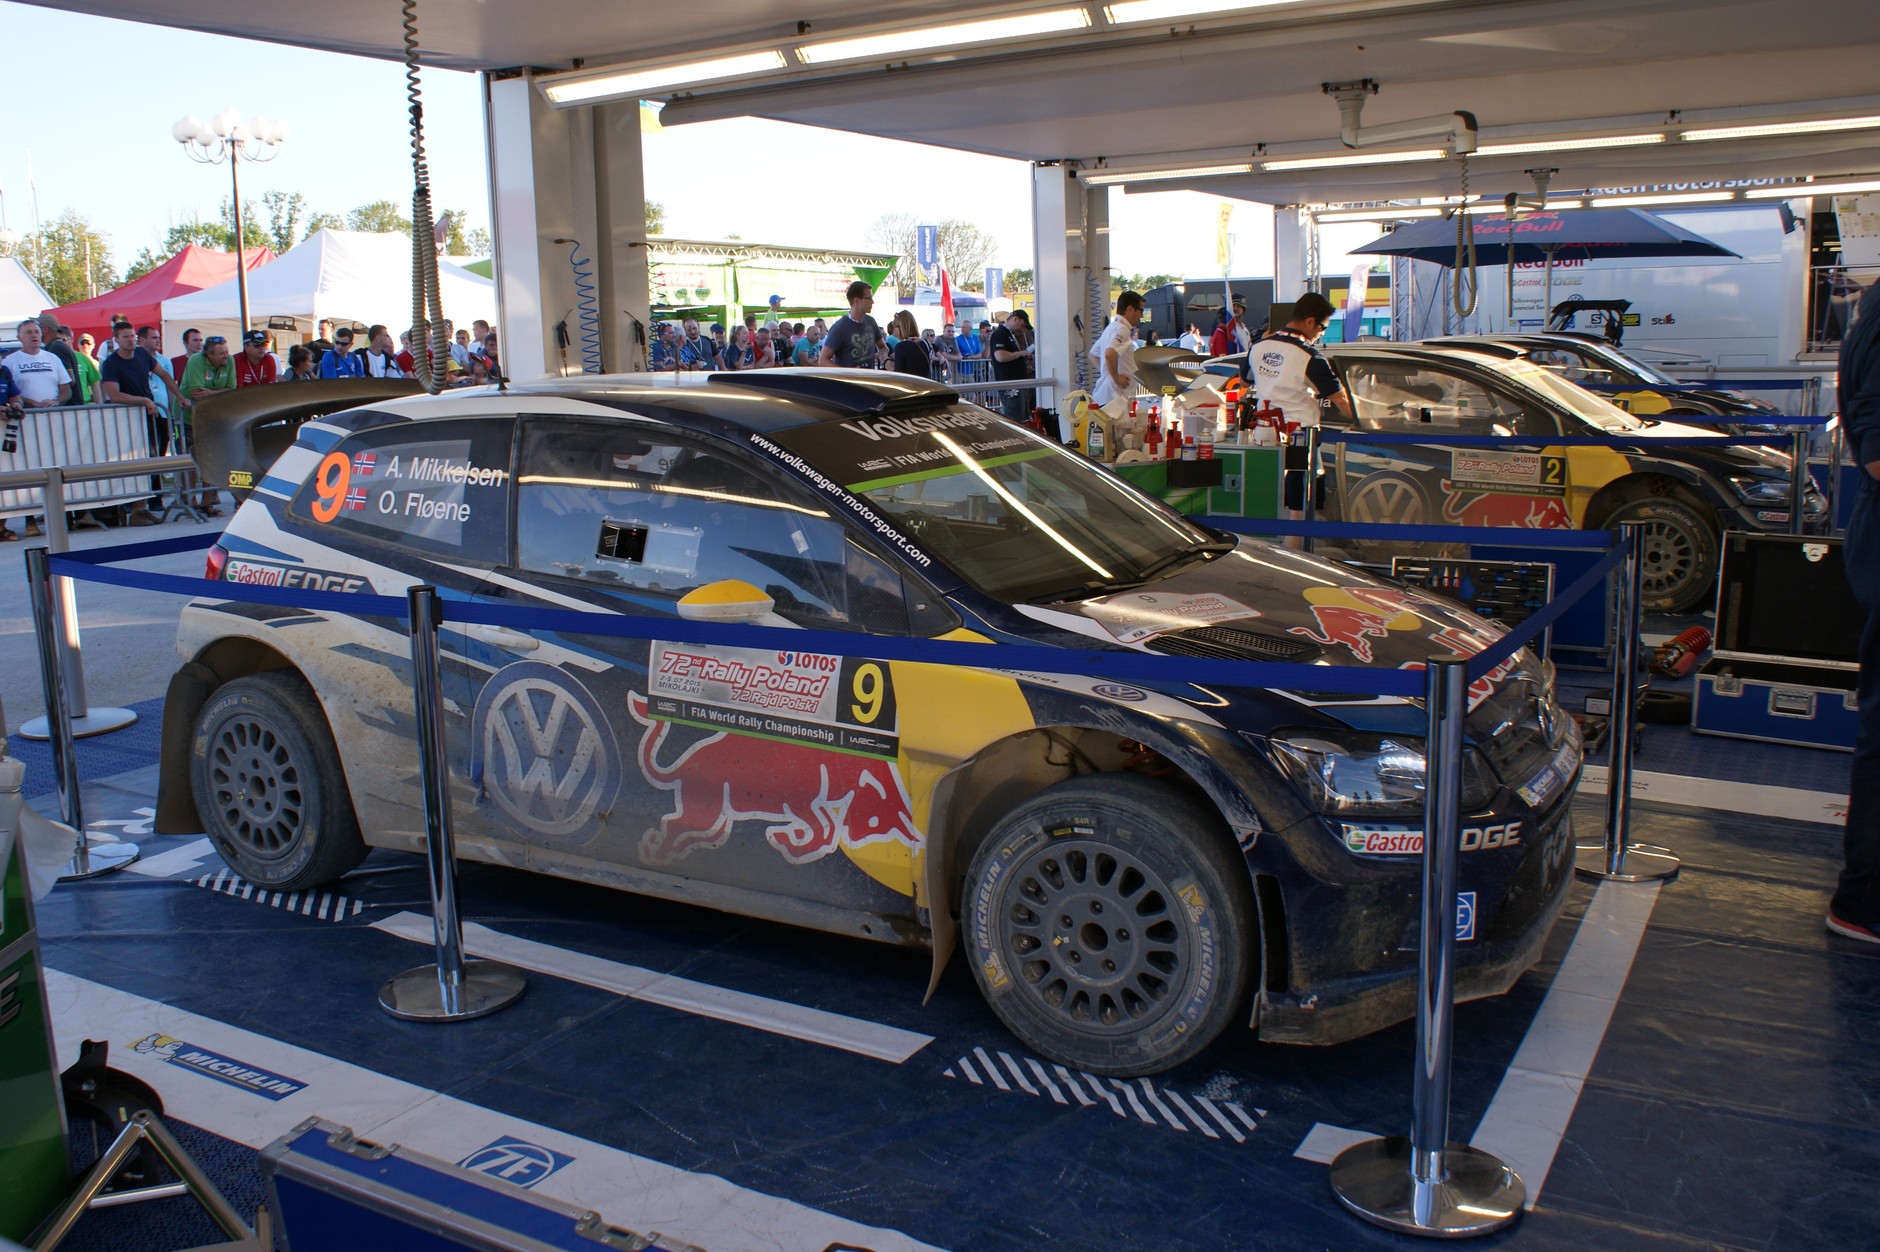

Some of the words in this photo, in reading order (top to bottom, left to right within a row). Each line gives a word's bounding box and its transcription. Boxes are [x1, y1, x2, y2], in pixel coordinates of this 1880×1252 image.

[1472, 221, 1514, 234] Red
[1514, 220, 1565, 233] Bull
[1517, 279, 1541, 287] Castrol
[19, 362, 51, 370] WRC
[841, 411, 998, 442] Volkswagen
[229, 473, 253, 488] OMP
[385, 456, 403, 478] A.
[409, 456, 504, 487] Mikkelsen
[1478, 462, 1501, 473] Rally
[1502, 463, 1537, 475] Poland
[1546, 459, 1560, 483] 2
[311, 452, 351, 524] 9
[750, 432, 932, 568] www.volkswagen-motorsport.com
[378, 490, 398, 514] O.
[405, 492, 471, 522] Fløene
[238, 564, 281, 587] Castrol
[1179, 602, 1227, 615] Poland
[795, 651, 837, 672] LOTOS
[702, 657, 752, 688] Rally
[751, 666, 829, 698] Poland
[991, 668, 1059, 684] ervices
[732, 688, 751, 701] 72
[750, 692, 780, 710] Rajd
[779, 697, 819, 713] Polski
[851, 663, 884, 724] 9
[708, 710, 736, 724] World
[738, 715, 763, 731] Rally
[765, 720, 835, 742] Championship
[1074, 816, 1089, 825] S4R
[1366, 832, 1423, 852] Castro
[1460, 821, 1523, 851] DGE
[978, 860, 1002, 950] MICHELIN
[178, 1051, 299, 1094] MICHELIN
[483, 1150, 543, 1179] ZF
